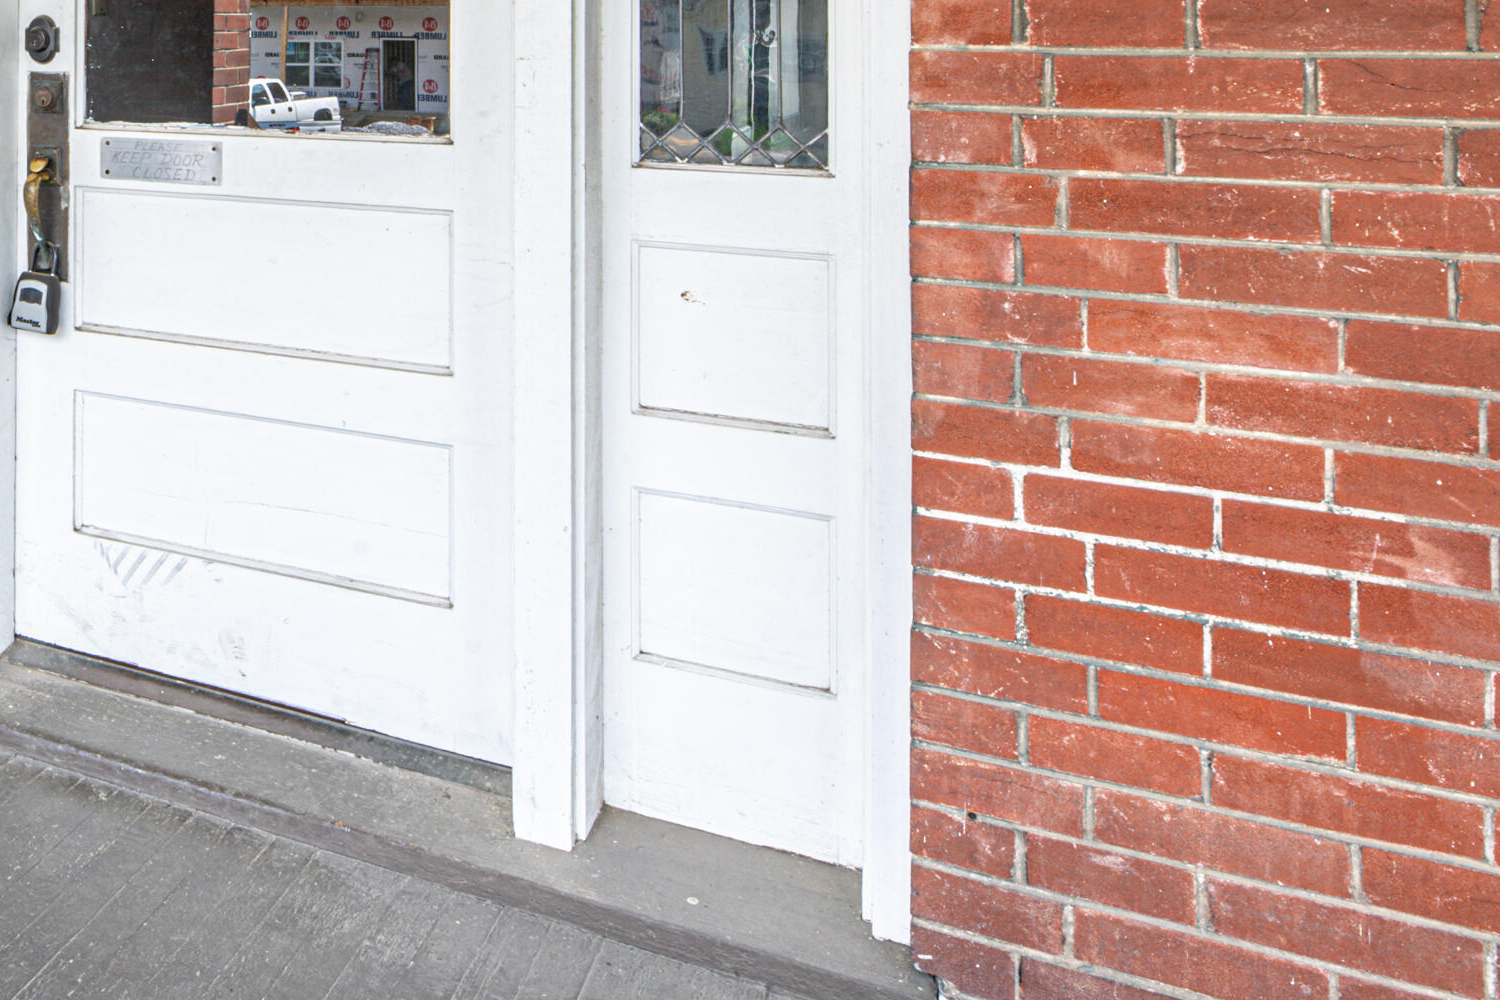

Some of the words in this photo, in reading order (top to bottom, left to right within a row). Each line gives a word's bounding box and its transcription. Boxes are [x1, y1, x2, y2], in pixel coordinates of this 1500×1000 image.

[134, 141, 182, 152] PLEASE
[111, 151, 152, 164] KEEP
[160, 153, 204, 167] DOOR
[133, 166, 196, 181] CLOSED
